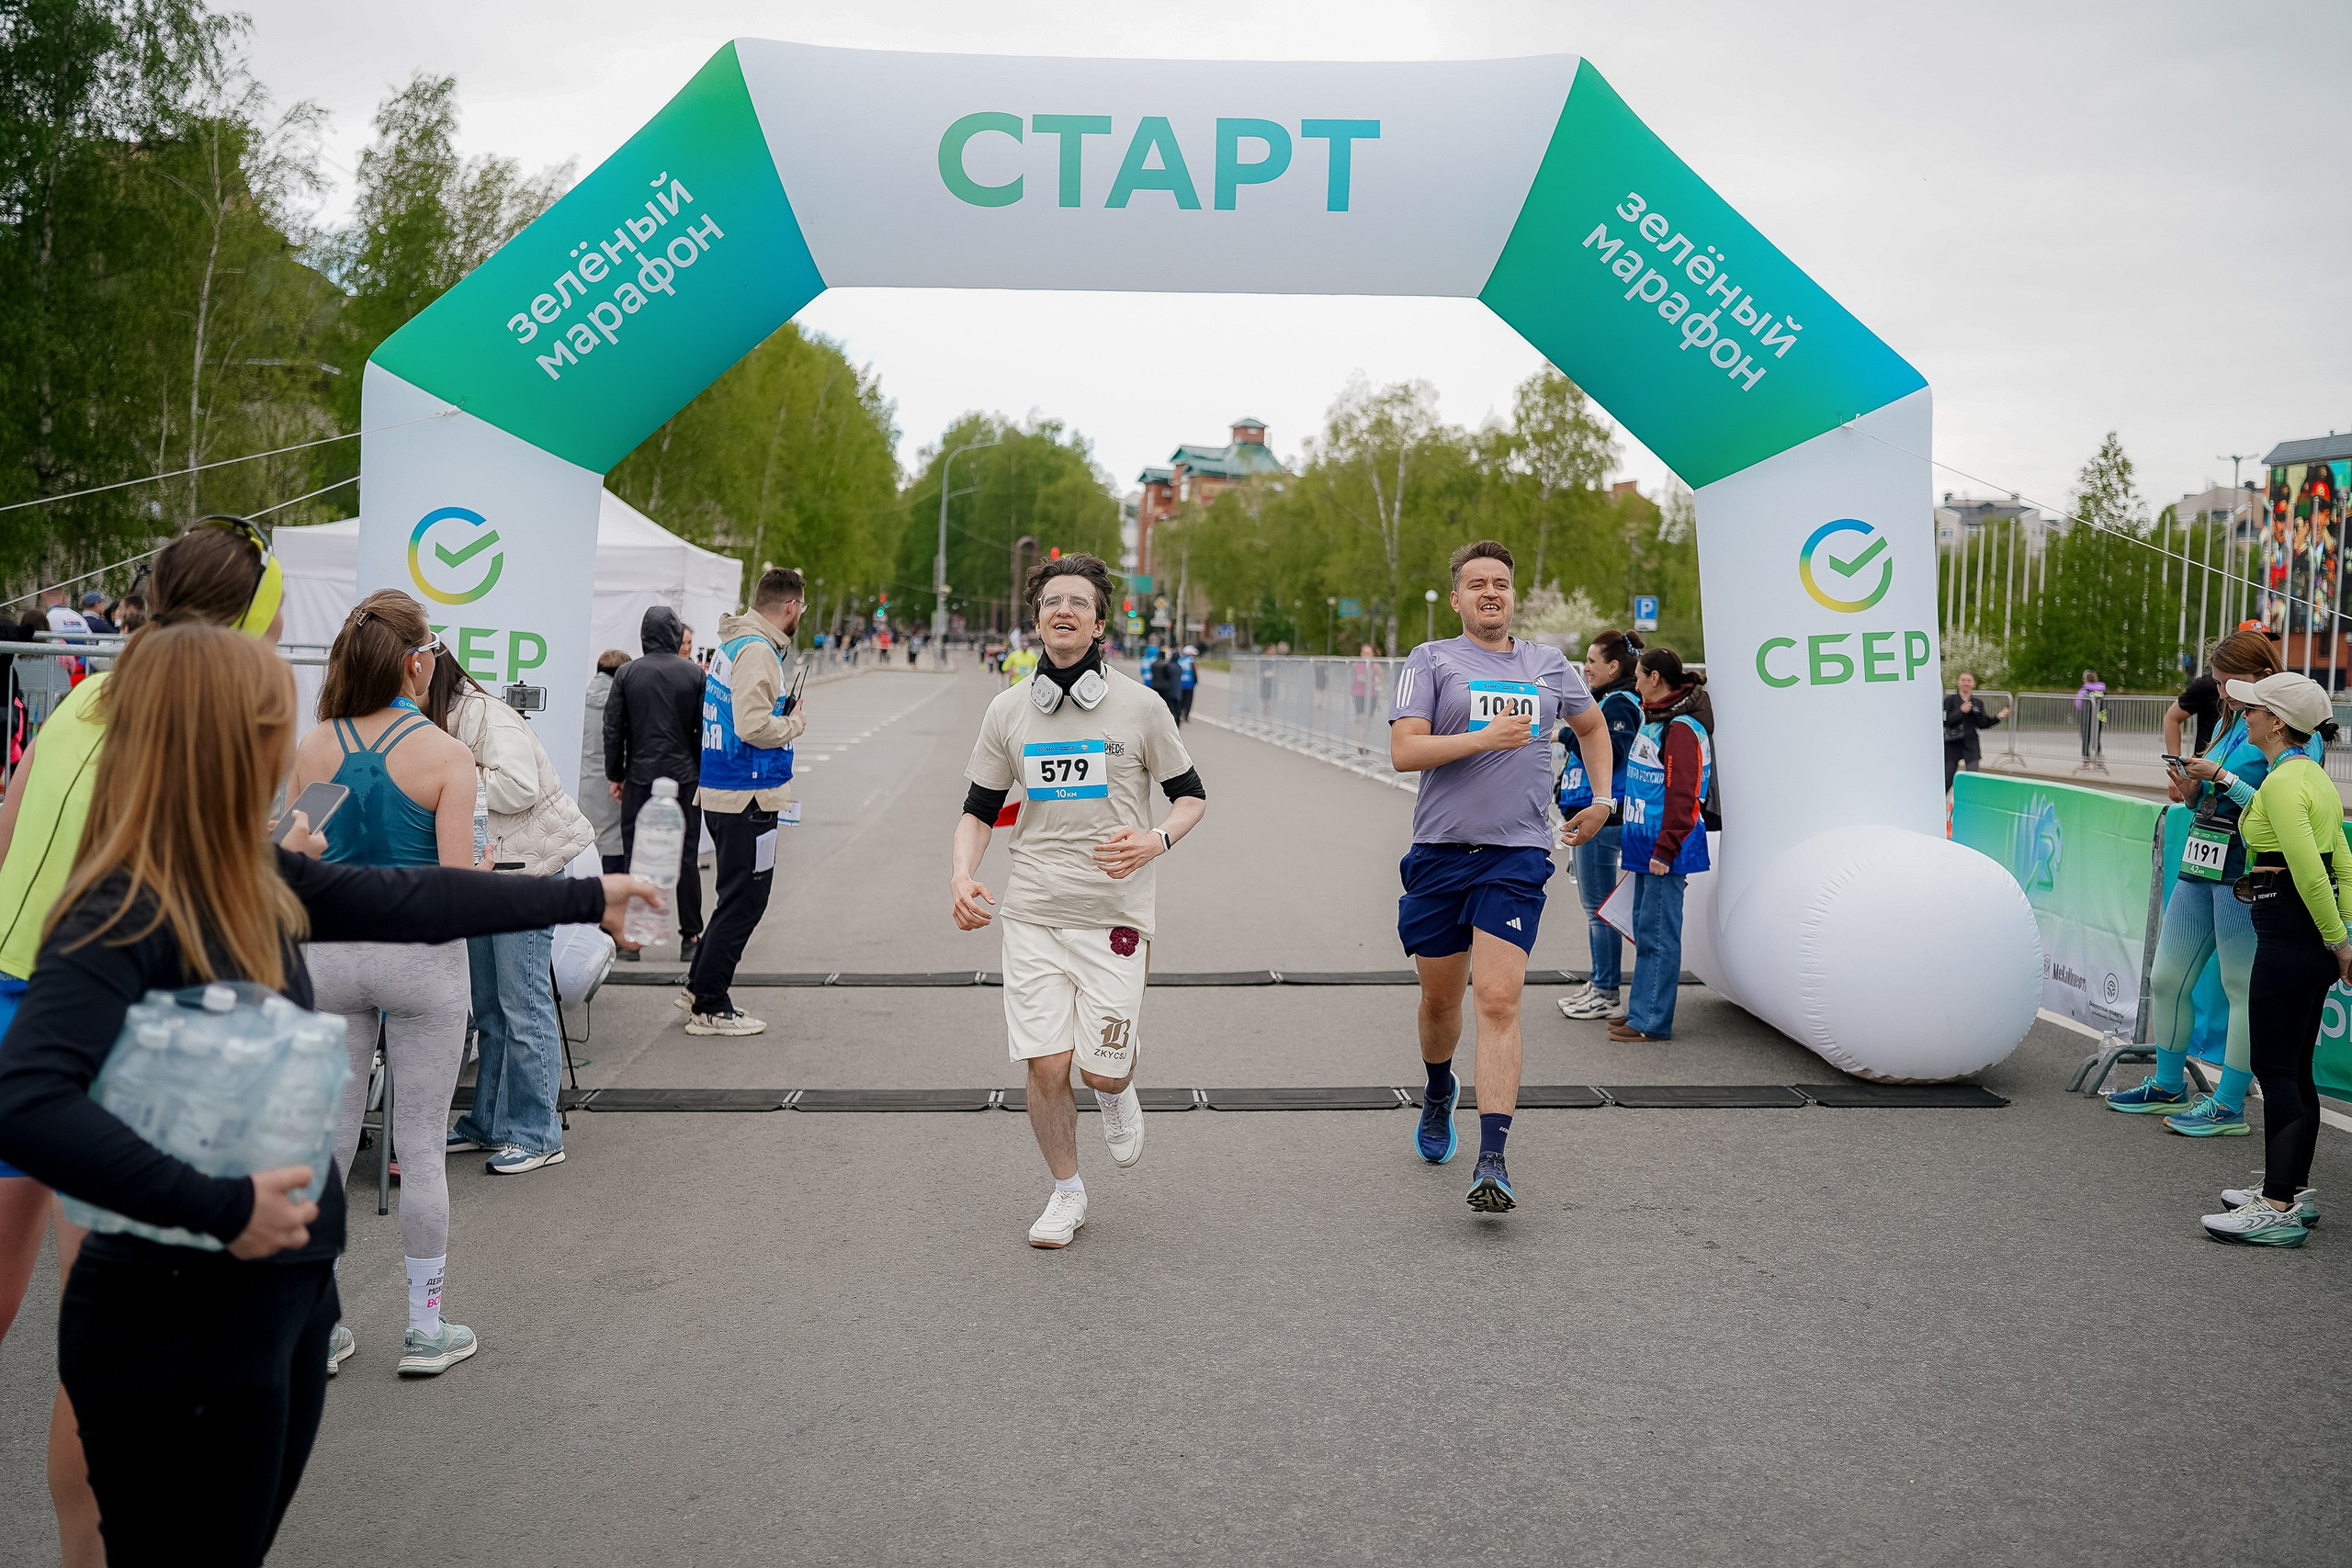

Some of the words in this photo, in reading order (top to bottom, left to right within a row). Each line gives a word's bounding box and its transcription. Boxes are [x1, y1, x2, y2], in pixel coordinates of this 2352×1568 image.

[937, 111, 1381, 212] СТАРТ
[506, 171, 695, 344] зелёный
[1615, 191, 1804, 359] зелёный
[535, 212, 725, 381] марафон
[1581, 222, 1768, 392] марафон
[1641, 599, 1654, 619] P
[429, 625, 548, 682] ЕР
[1756, 631, 1930, 688] СБЕР
[1040, 758, 1090, 783] 579
[1055, 789, 1067, 798] 10
[2188, 840, 2220, 864] 1191
